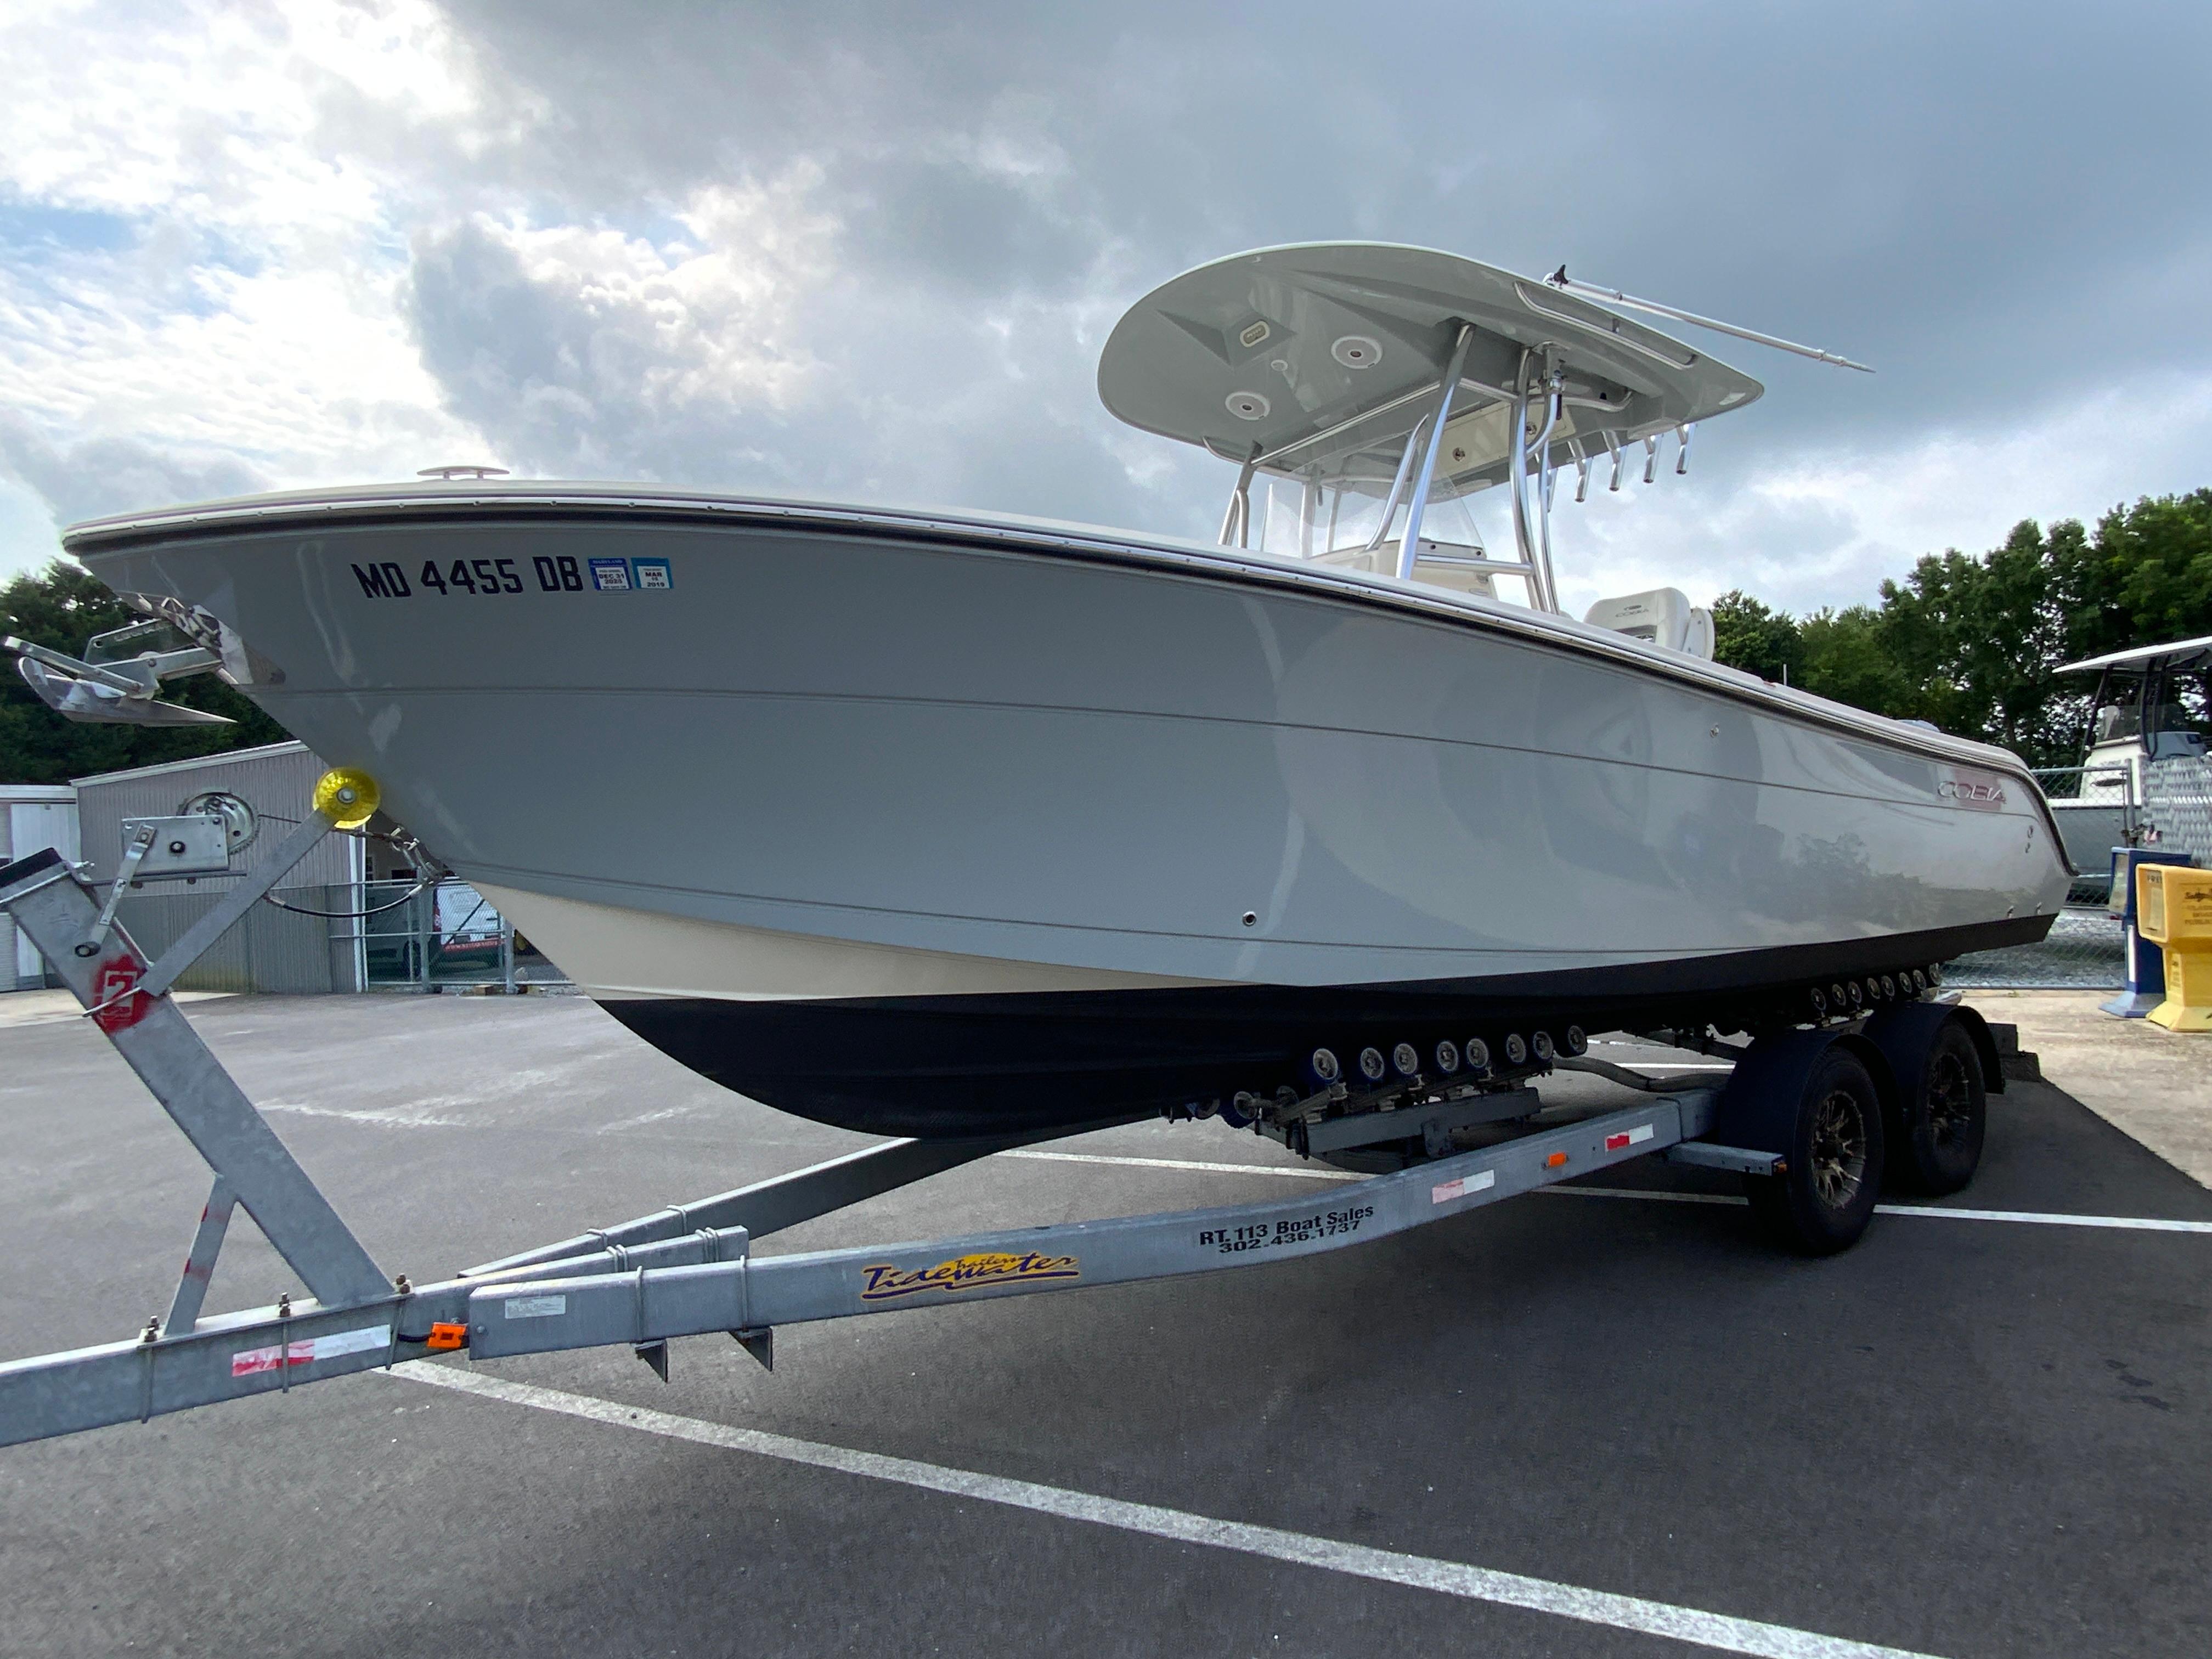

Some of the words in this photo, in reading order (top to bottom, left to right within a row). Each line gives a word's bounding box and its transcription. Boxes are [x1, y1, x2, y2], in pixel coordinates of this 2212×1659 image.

[351, 563, 411, 599] MD
[420, 558, 524, 595] 4455
[532, 556, 584, 592] DB
[1937, 780, 2007, 804] COBIA
[1199, 1229, 1231, 1245] RT.
[1234, 1224, 1268, 1239] 113
[1276, 1215, 1322, 1234] Boat
[1326, 1206, 1374, 1225] Sales
[862, 1251, 1077, 1292] Tidewater
